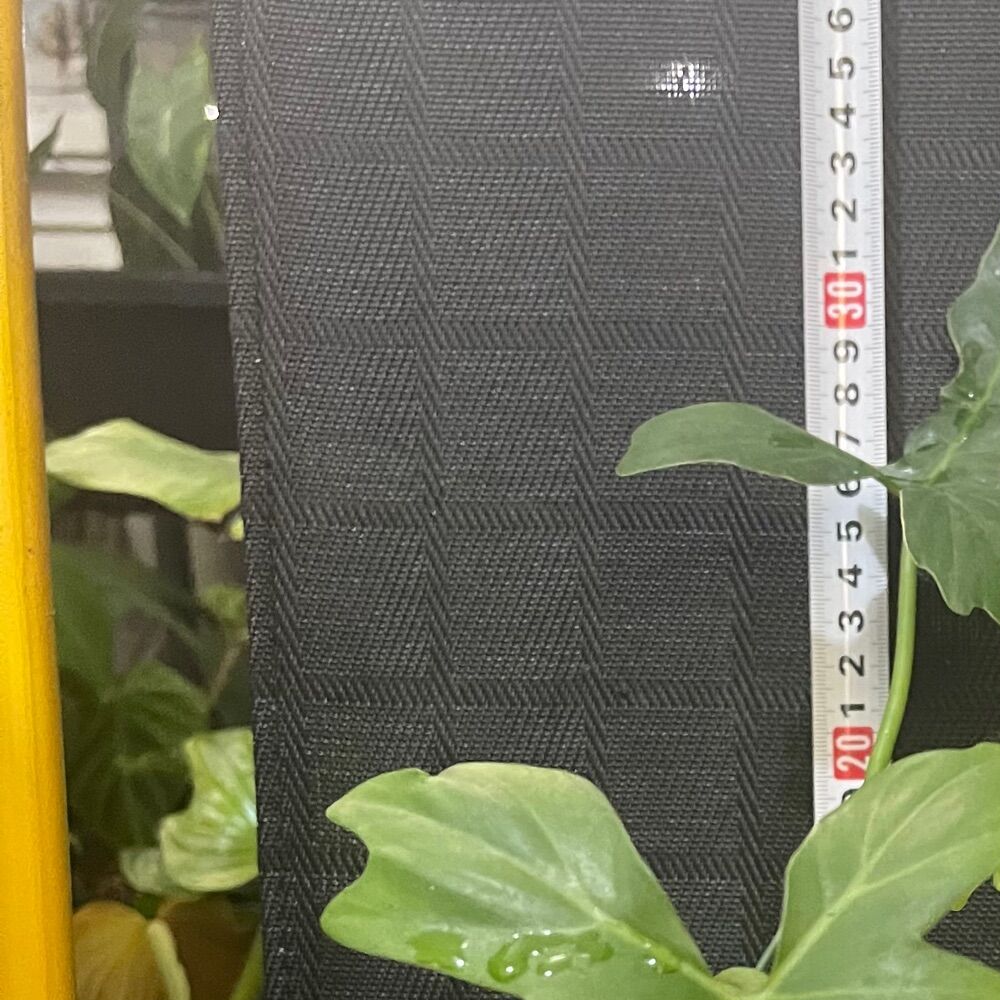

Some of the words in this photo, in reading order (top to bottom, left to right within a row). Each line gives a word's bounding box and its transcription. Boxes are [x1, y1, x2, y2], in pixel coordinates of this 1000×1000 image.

[828, 7, 853, 33] 6
[829, 57, 855, 80] 5
[830, 103, 856, 129] 4
[830, 152, 856, 176] 3
[831, 198, 857, 222] 2
[832, 250, 858, 266] 1
[826, 280, 864, 320] 30
[833, 339, 859, 363] 9
[834, 382, 859, 406] 8
[835, 429, 861, 448] 7
[836, 520, 862, 542] 5
[837, 564, 863, 589] 4
[838, 610, 864, 633] 3
[839, 654, 865, 677] 2
[840, 703, 865, 718] 1
[836, 734, 871, 772] 20
